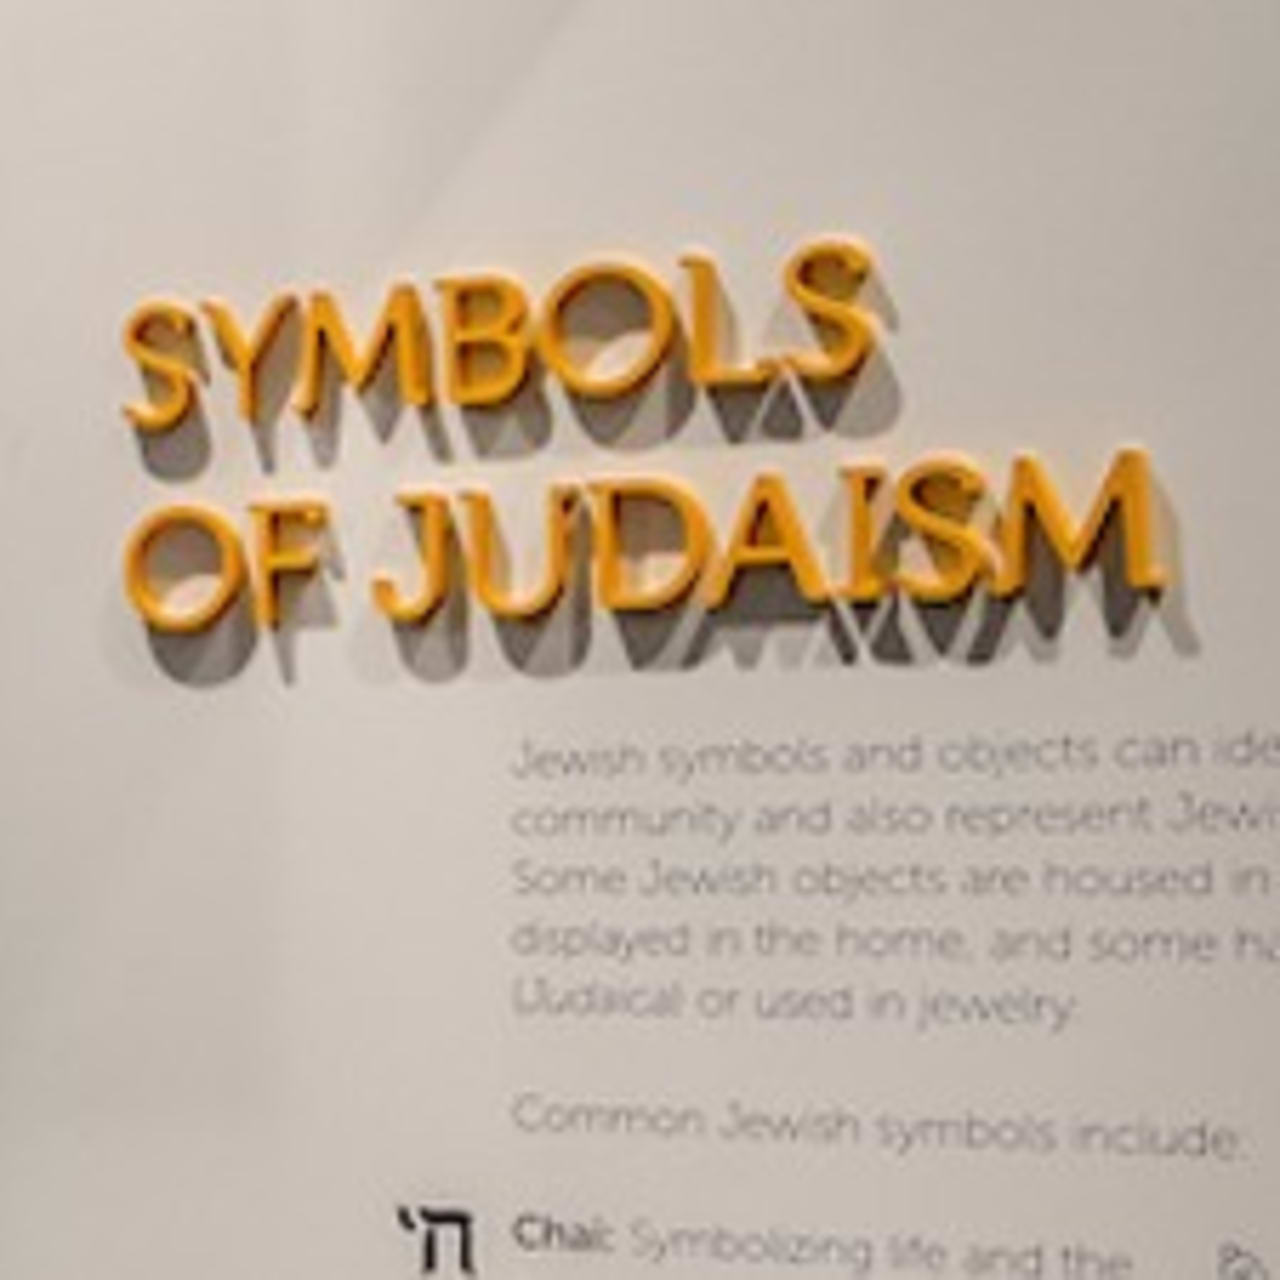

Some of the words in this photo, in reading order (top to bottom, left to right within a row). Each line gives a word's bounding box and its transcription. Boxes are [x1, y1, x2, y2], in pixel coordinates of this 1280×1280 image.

[120, 235, 877, 433] SYMBOLS
[123, 500, 332, 634] OF
[371, 448, 1167, 624] JUDAISM
[509, 735, 646, 780] Jewish
[658, 734, 832, 785] symbols
[843, 732, 923, 773] and
[938, 730, 1100, 780] objects
[1113, 735, 1199, 770] can
[509, 800, 738, 847] community
[754, 796, 832, 836] and
[845, 794, 933, 836] also
[943, 793, 1151, 841] represent
[509, 856, 628, 896] Some
[638, 856, 778, 898] Jewish
[793, 858, 948, 906] objects
[959, 865, 1031, 896] are
[1042, 858, 1214, 897] housed
[1229, 858, 1272, 896] in
[508, 919, 689, 964] displayed
[706, 920, 741, 957] in
[753, 920, 821, 958] the
[989, 923, 1071, 962] and
[1086, 926, 1219, 964] some
[695, 987, 743, 1018] or
[754, 981, 855, 1021] used
[868, 982, 907, 1022] in
[510, 1091, 706, 1138] Common
[716, 1096, 861, 1143] Jewish
[875, 1111, 1059, 1157] symbols
[629, 1216, 873, 1277] Symbolizing
[886, 1231, 949, 1274] life
[960, 1237, 1044, 1280] and
[1059, 1239, 1137, 1280] the
